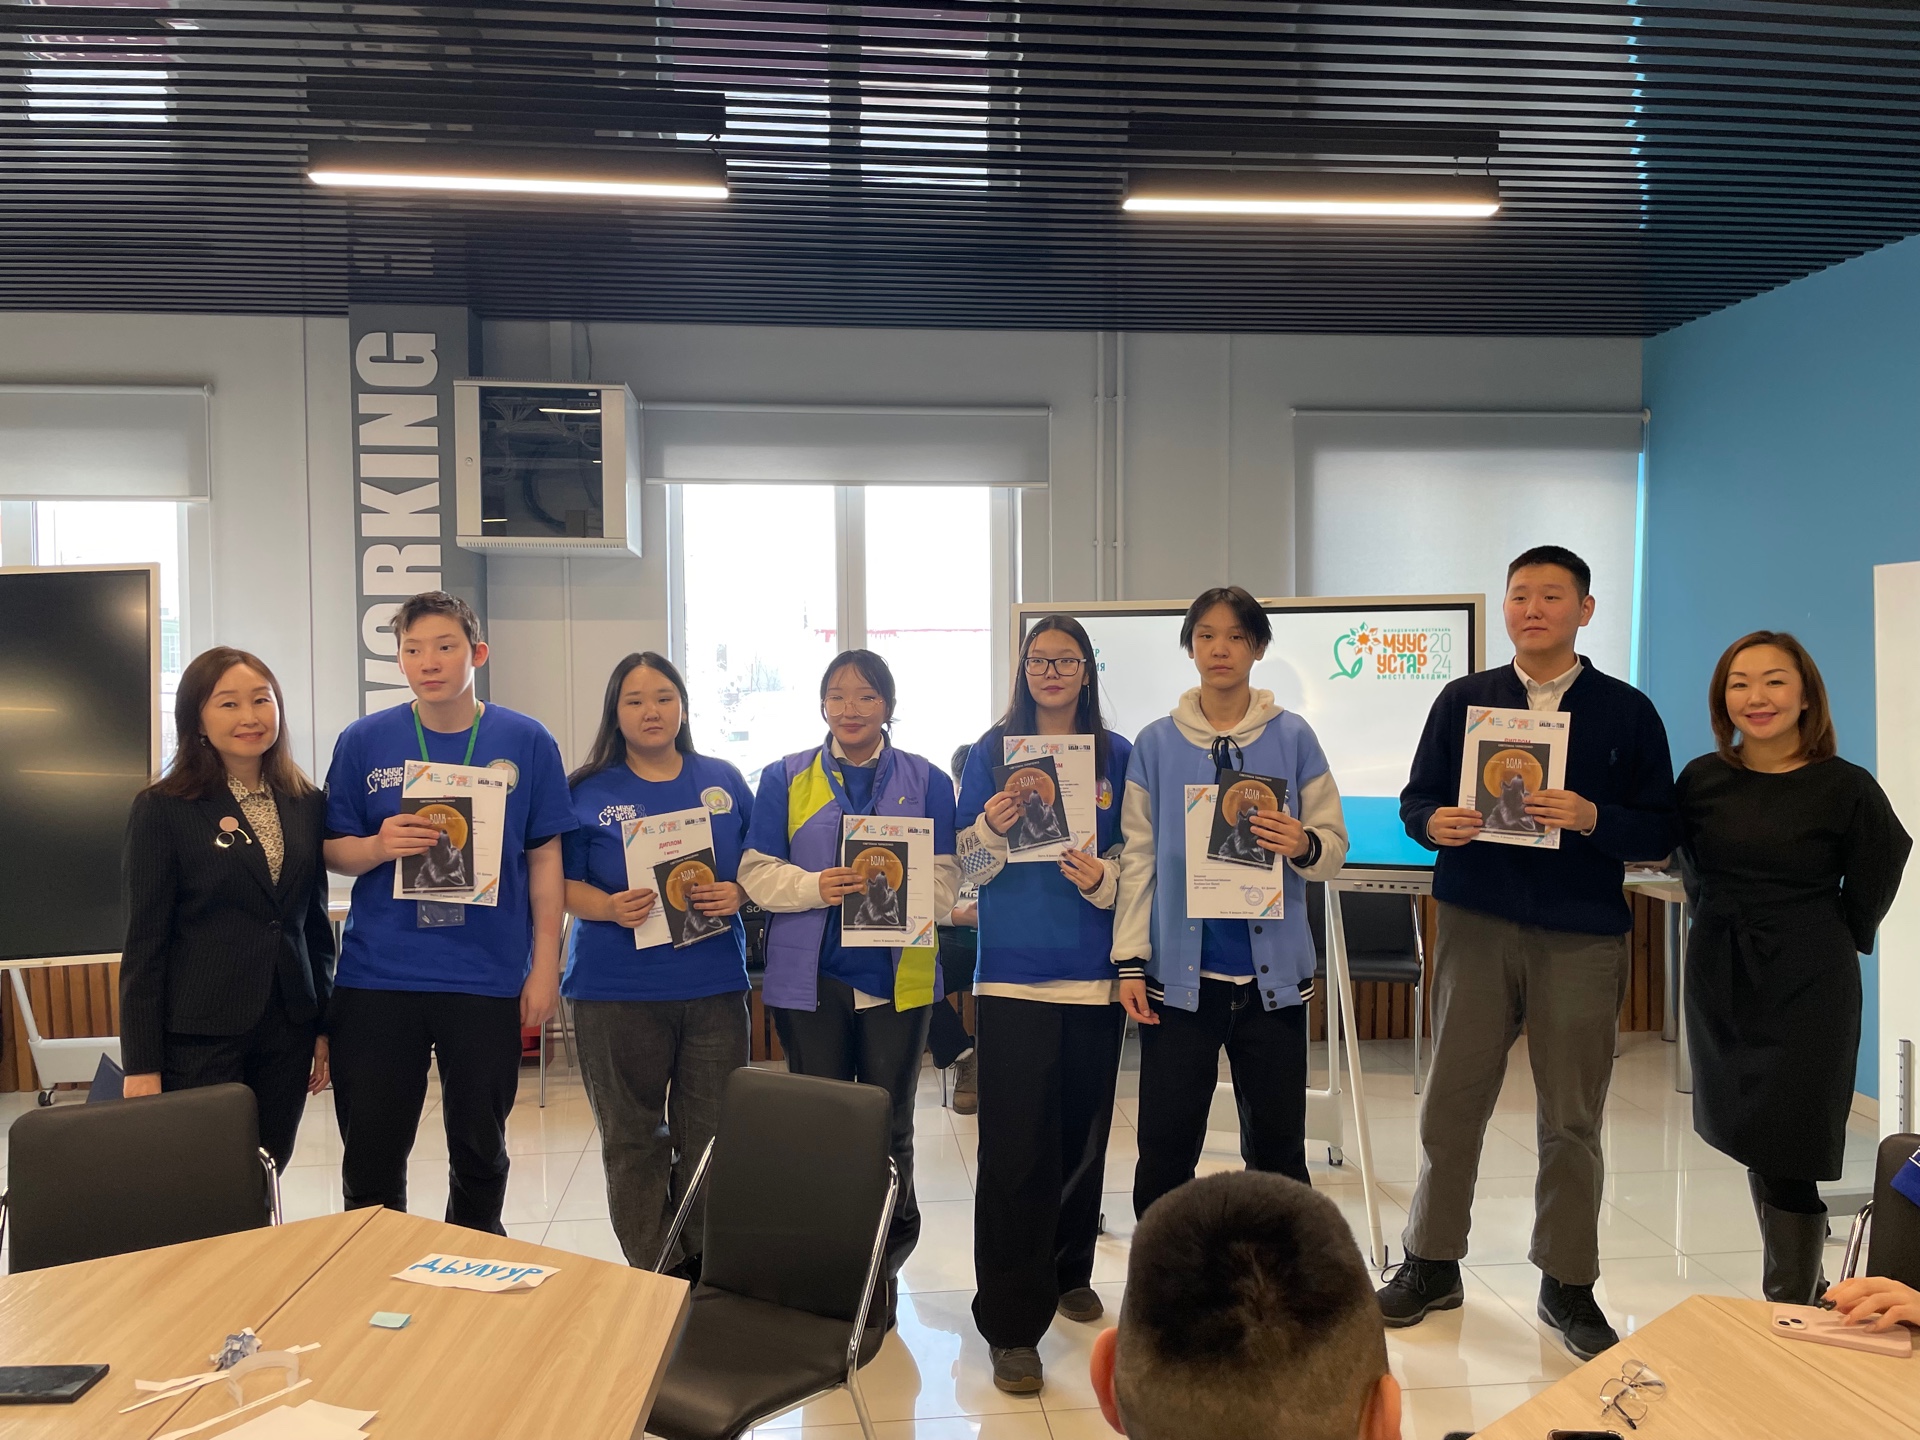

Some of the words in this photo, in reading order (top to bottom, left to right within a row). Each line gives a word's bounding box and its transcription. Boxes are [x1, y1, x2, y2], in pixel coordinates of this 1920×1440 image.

[1429, 632, 1452, 653] 20
[1377, 653, 1428, 674] УСТАР
[1432, 654, 1452, 674] 24
